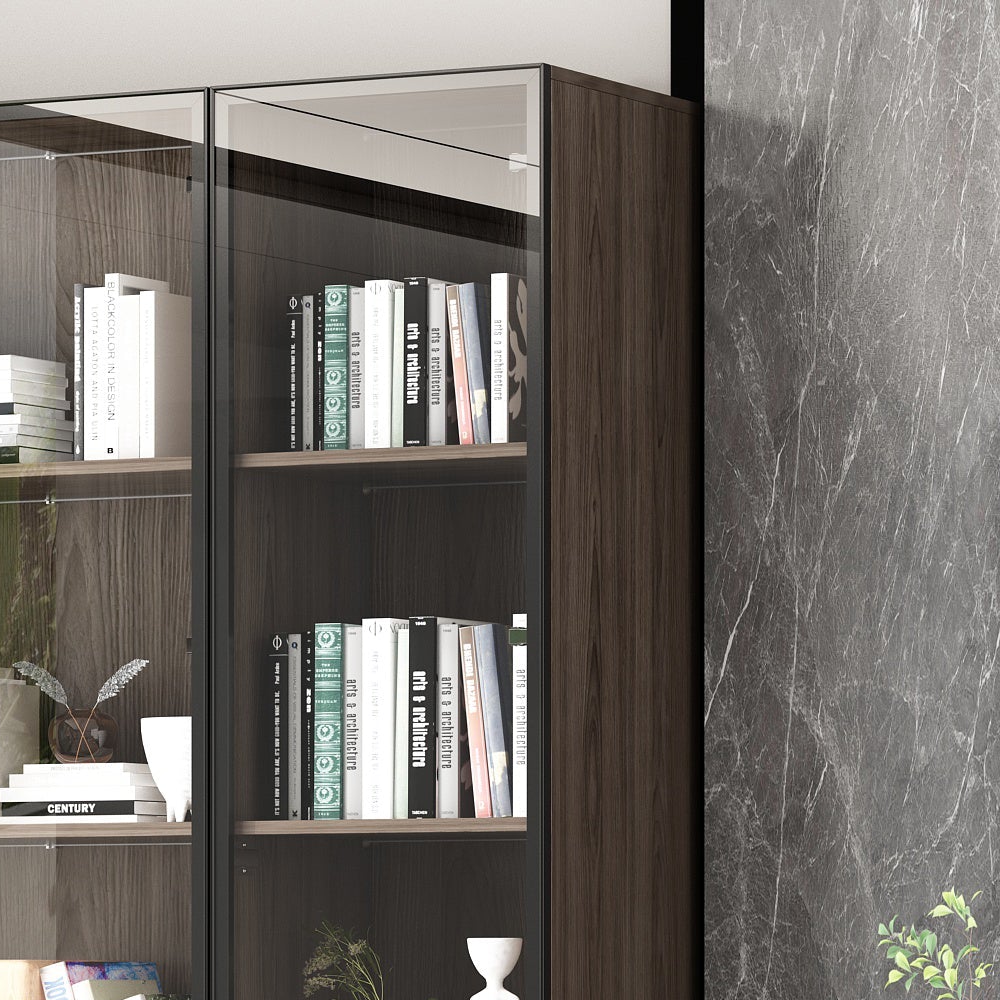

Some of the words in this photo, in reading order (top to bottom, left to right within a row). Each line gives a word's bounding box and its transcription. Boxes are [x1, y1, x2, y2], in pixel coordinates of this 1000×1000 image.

[107, 281, 116, 359] BLACKCOLOR
[494, 320, 504, 336] arts
[351, 331, 361, 348] arts
[431, 328, 441, 344] arts
[107, 363, 116, 374] IN
[494, 350, 504, 401] architecture
[91, 380, 99, 398] AND
[351, 360, 362, 409] architecture
[431, 356, 442, 406] architecture
[107, 377, 116, 421] DESIGN
[346, 679, 358, 698] arts
[441, 676, 453, 695] arts
[346, 713, 359, 771] architecture
[441, 711, 455, 769] architecture
[47, 803, 96, 814] CENTURY
